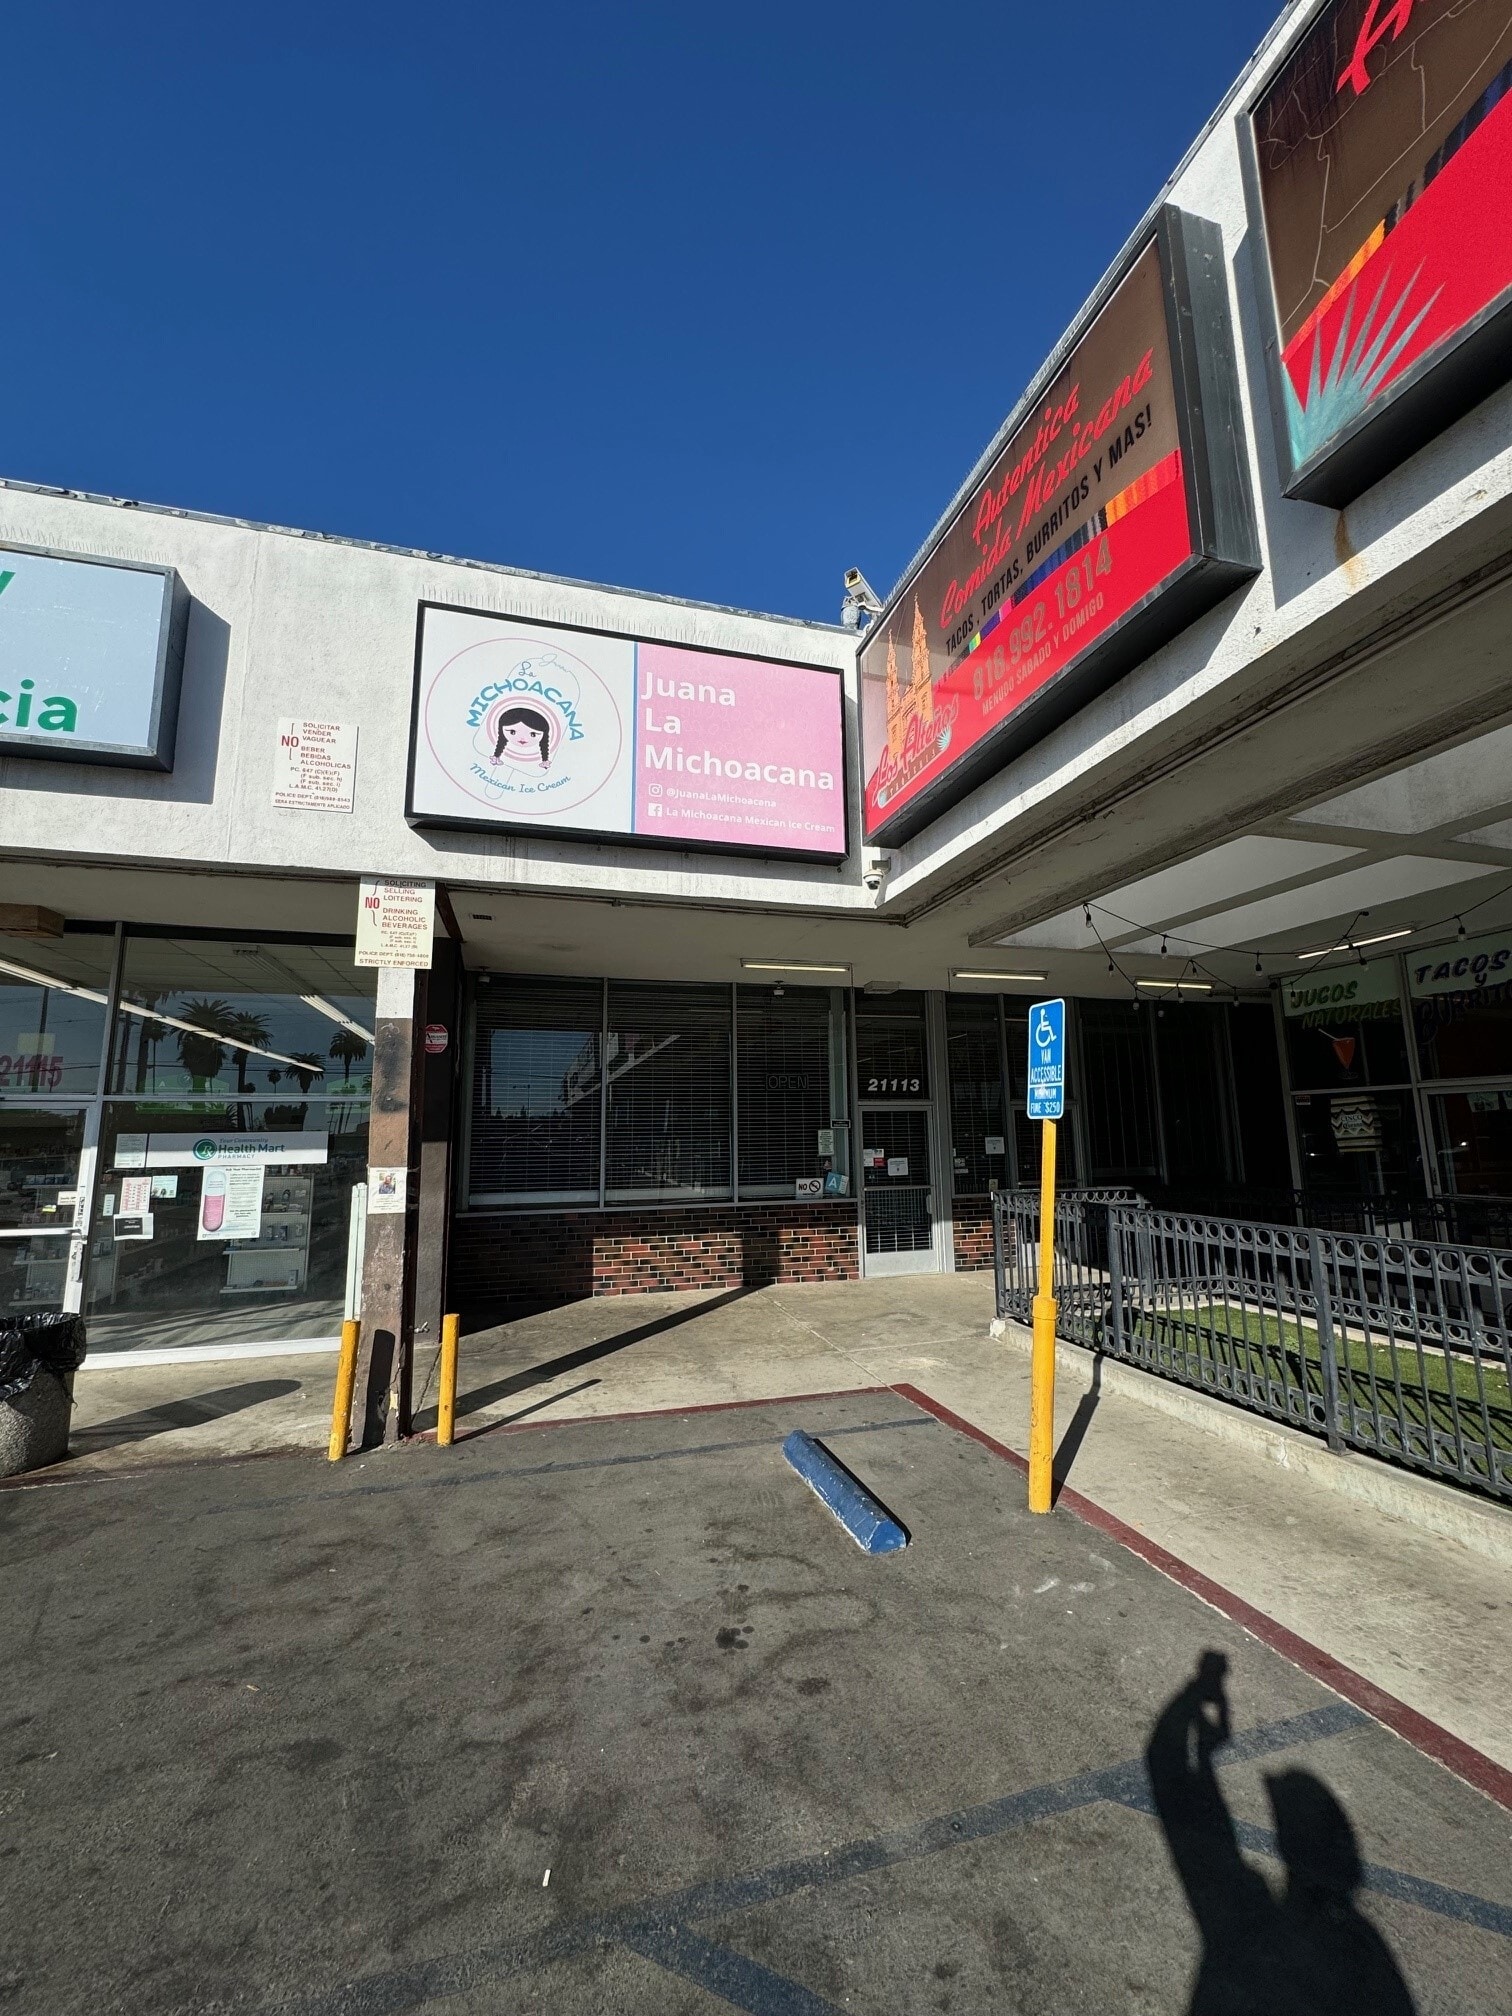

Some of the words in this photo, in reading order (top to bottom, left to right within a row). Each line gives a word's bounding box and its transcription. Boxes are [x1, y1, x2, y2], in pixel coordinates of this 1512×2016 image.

[973, 382, 1080, 546] Autentica
[940, 516, 1012, 629] Comida
[1015, 346, 1153, 541] Mexicana
[1026, 476, 1090, 565] BURRITOS
[1093, 457, 1102, 483] Y
[1108, 403, 1152, 470] MAS!
[982, 678, 1014, 718] MENUDO
[1016, 642, 1051, 685] SABADO
[1054, 635, 1060, 650] Y
[1063, 592, 1104, 642] DOMIGO
[518, 661, 537, 678] La
[640, 671, 736, 706] Juana
[466, 678, 585, 741] MICHOACANA
[303, 722, 341, 731] SOLICITAR
[645, 707, 681, 735] La
[281, 735, 299, 747] NO
[300, 760, 351, 769] ALCOHOLICAS
[645, 744, 834, 791] Michoacana
[470, 763, 516, 791] Mexican
[519, 784, 536, 793] Ice
[537, 776, 571, 792] Cream
[666, 808, 678, 817] La
[681, 809, 742, 823] Michoacana
[745, 816, 786, 828] Mexican
[788, 820, 802, 829] Ice
[804, 822, 835, 833] Cream
[384, 880, 426, 888] SOLICITING
[365, 896, 380, 909] NO
[382, 915, 426, 923] ALCOHOLIC
[382, 922, 428, 930] BEVERAGES
[1415, 949, 1511, 985] TACOS
[1291, 980, 1358, 1008] JUGOS
[1041, 1048, 1052, 1064] VAN
[0, 1055, 64, 1087] 21115
[1030, 1064, 1062, 1084] ACCESSIBLE
[768, 1075, 807, 1089] OPEN
[867, 1078, 920, 1092] 21113
[1030, 1102, 1042, 1113] FINE
[1044, 1102, 1061, 1114] $250
[218, 1143, 256, 1154] Health
[258, 1143, 286, 1153] Mart
[798, 1183, 808, 1191] NO
[828, 1176, 838, 1189] A
